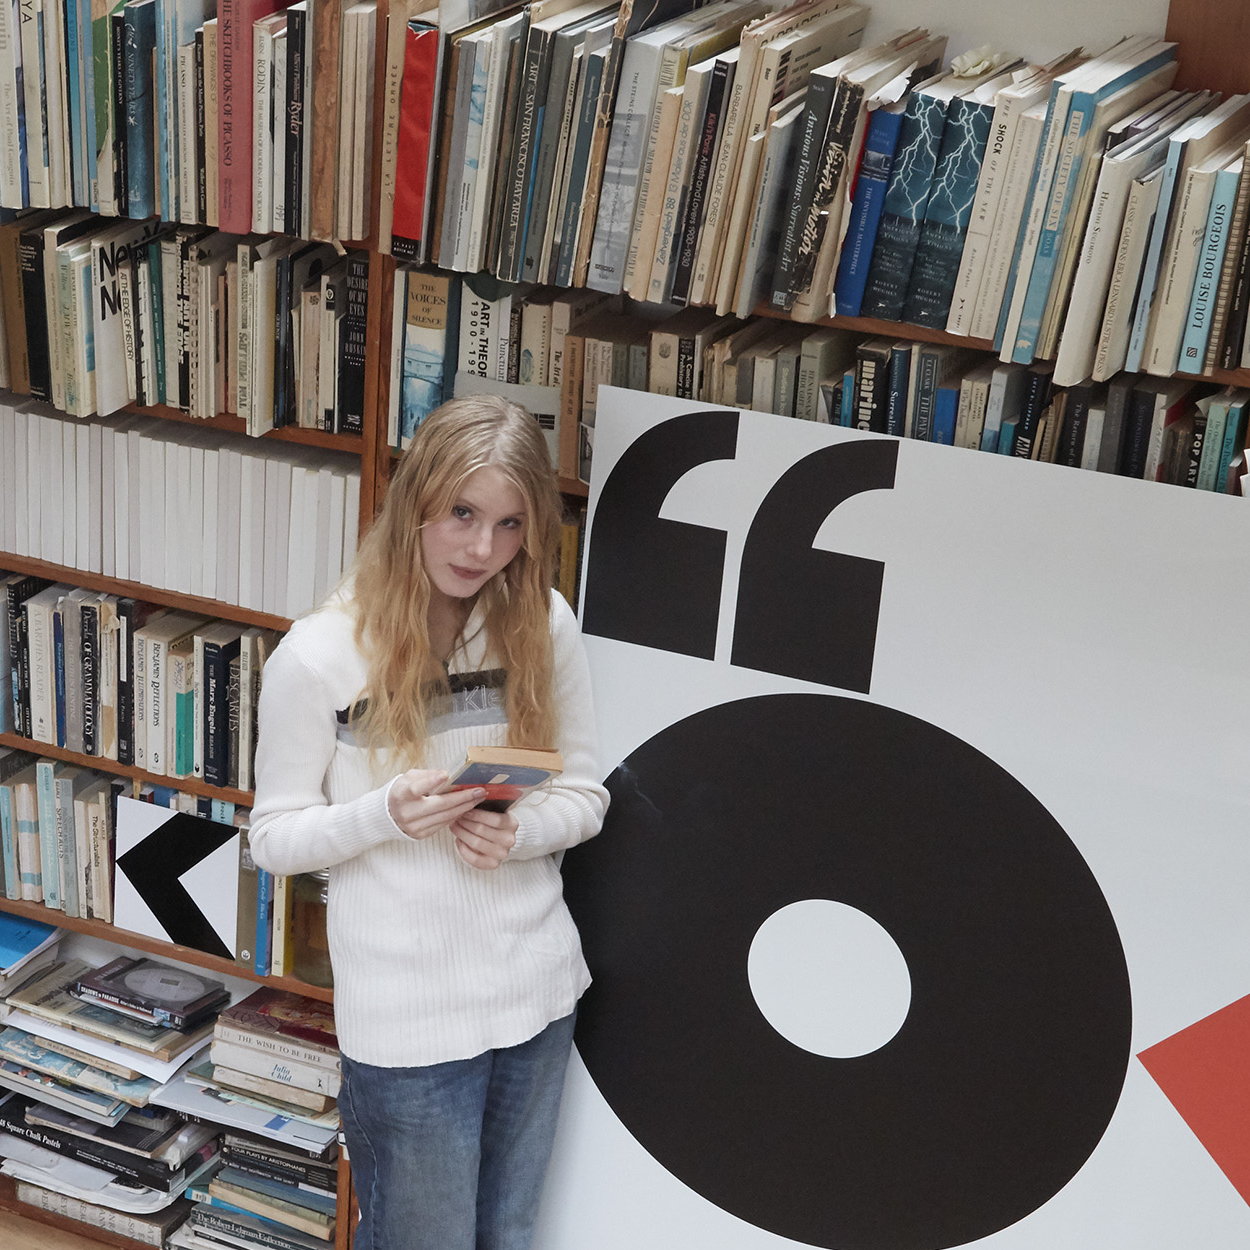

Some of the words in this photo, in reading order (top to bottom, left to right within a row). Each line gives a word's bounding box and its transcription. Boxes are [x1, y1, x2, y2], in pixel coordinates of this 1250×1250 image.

[126, 51, 135, 85] NINETY
[222, 19, 232, 101] SKETCHBOOKS
[526, 60, 539, 84] ART
[256, 59, 265, 94] RODIN
[522, 93, 535, 115] SAN
[628, 84, 637, 107] STEINS
[1001, 98, 1011, 118] THE
[222, 104, 231, 117] OF
[286, 101, 302, 134] Ryder
[681, 98, 693, 121] DDR
[725, 83, 742, 137] BARBARELLA
[623, 109, 633, 138] COLLECT
[678, 122, 688, 138] der
[705, 112, 716, 134] Kiki's
[800, 109, 818, 158] Anxious
[1068, 113, 1081, 138] THE
[222, 122, 231, 166] PICASSO
[513, 116, 532, 178] FRANCISCO
[677, 139, 686, 156] aus
[991, 123, 1006, 155] SHOCK
[670, 157, 683, 183] Maler
[697, 155, 709, 181] Artists
[988, 159, 997, 173] OF
[1057, 139, 1075, 187] SOCIETY
[511, 179, 523, 201] BAY
[694, 180, 704, 198] and
[793, 158, 810, 201] Visions:
[983, 176, 994, 196] THE
[689, 197, 701, 224] Lovers
[1053, 190, 1063, 206] OF
[1125, 194, 1138, 224] CLASSIC
[507, 200, 520, 227] AREA
[707, 196, 720, 228] FOREST
[857, 200, 869, 231] INVISIBLE
[977, 201, 987, 221] NEW
[1048, 208, 1059, 228] SIX
[657, 211, 675, 265] Zeitvergleich
[784, 202, 802, 252] Surrealist
[849, 233, 863, 275] MASTERPIECE
[1042, 232, 1053, 254] BOAS
[1117, 226, 1132, 261] GARDENS
[352, 264, 364, 276] THE
[780, 251, 793, 272] Art
[1113, 261, 1125, 284] ERICA
[1191, 281, 1211, 328] LOUISE
[1201, 202, 1226, 279] BOURGEOIS
[120, 281, 129, 297] THE
[356, 290, 366, 302] MY
[410, 292, 446, 305] VOICES
[420, 284, 436, 292] THE
[122, 297, 130, 317] EDGE
[350, 303, 365, 316] EYES
[479, 301, 490, 328] ART
[123, 316, 131, 329] OF
[412, 314, 442, 326] SILENCE
[125, 330, 134, 361] HISTORY
[182, 330, 189, 351] ON
[349, 331, 364, 342] JOHN
[677, 353, 685, 387] Prehistory
[684, 364, 692, 388] Concise
[780, 367, 788, 394] Studies
[238, 385, 246, 408] TOM
[919, 394, 930, 415] THE
[1073, 402, 1082, 418] The
[1070, 419, 1080, 446] Return
[1191, 433, 1202, 456] POP
[1187, 459, 1198, 484] ART
[34, 619, 43, 660] BARTHES
[83, 642, 91, 657] OF
[136, 638, 144, 672] BENJAMIN
[151, 643, 160, 678] BENJAMIN
[35, 662, 44, 702] READER
[83, 657, 92, 738] GRAMMATOLOGY
[150, 680, 159, 727] REFLECTIONS
[228, 666, 239, 731] DESCARTES
[237, 1034, 253, 1044] THE
[256, 1038, 276, 1050] WISH
[279, 1045, 290, 1054] TO
[291, 1048, 302, 1058] BE
[304, 1053, 322, 1064] FREE
[271, 1071, 292, 1083] Child
[272, 1063, 291, 1076] Julia
[4, 1121, 26, 1136] Square
[24, 1128, 43, 1141] Chalk
[41, 1135, 62, 1149] Pastels
[230, 1147, 245, 1156] FOUR
[245, 1151, 261, 1160] PLAYS
[268, 1157, 307, 1173] ARISTOPHANES
[198, 1213, 210, 1224] The
[210, 1217, 230, 1229] Robert
